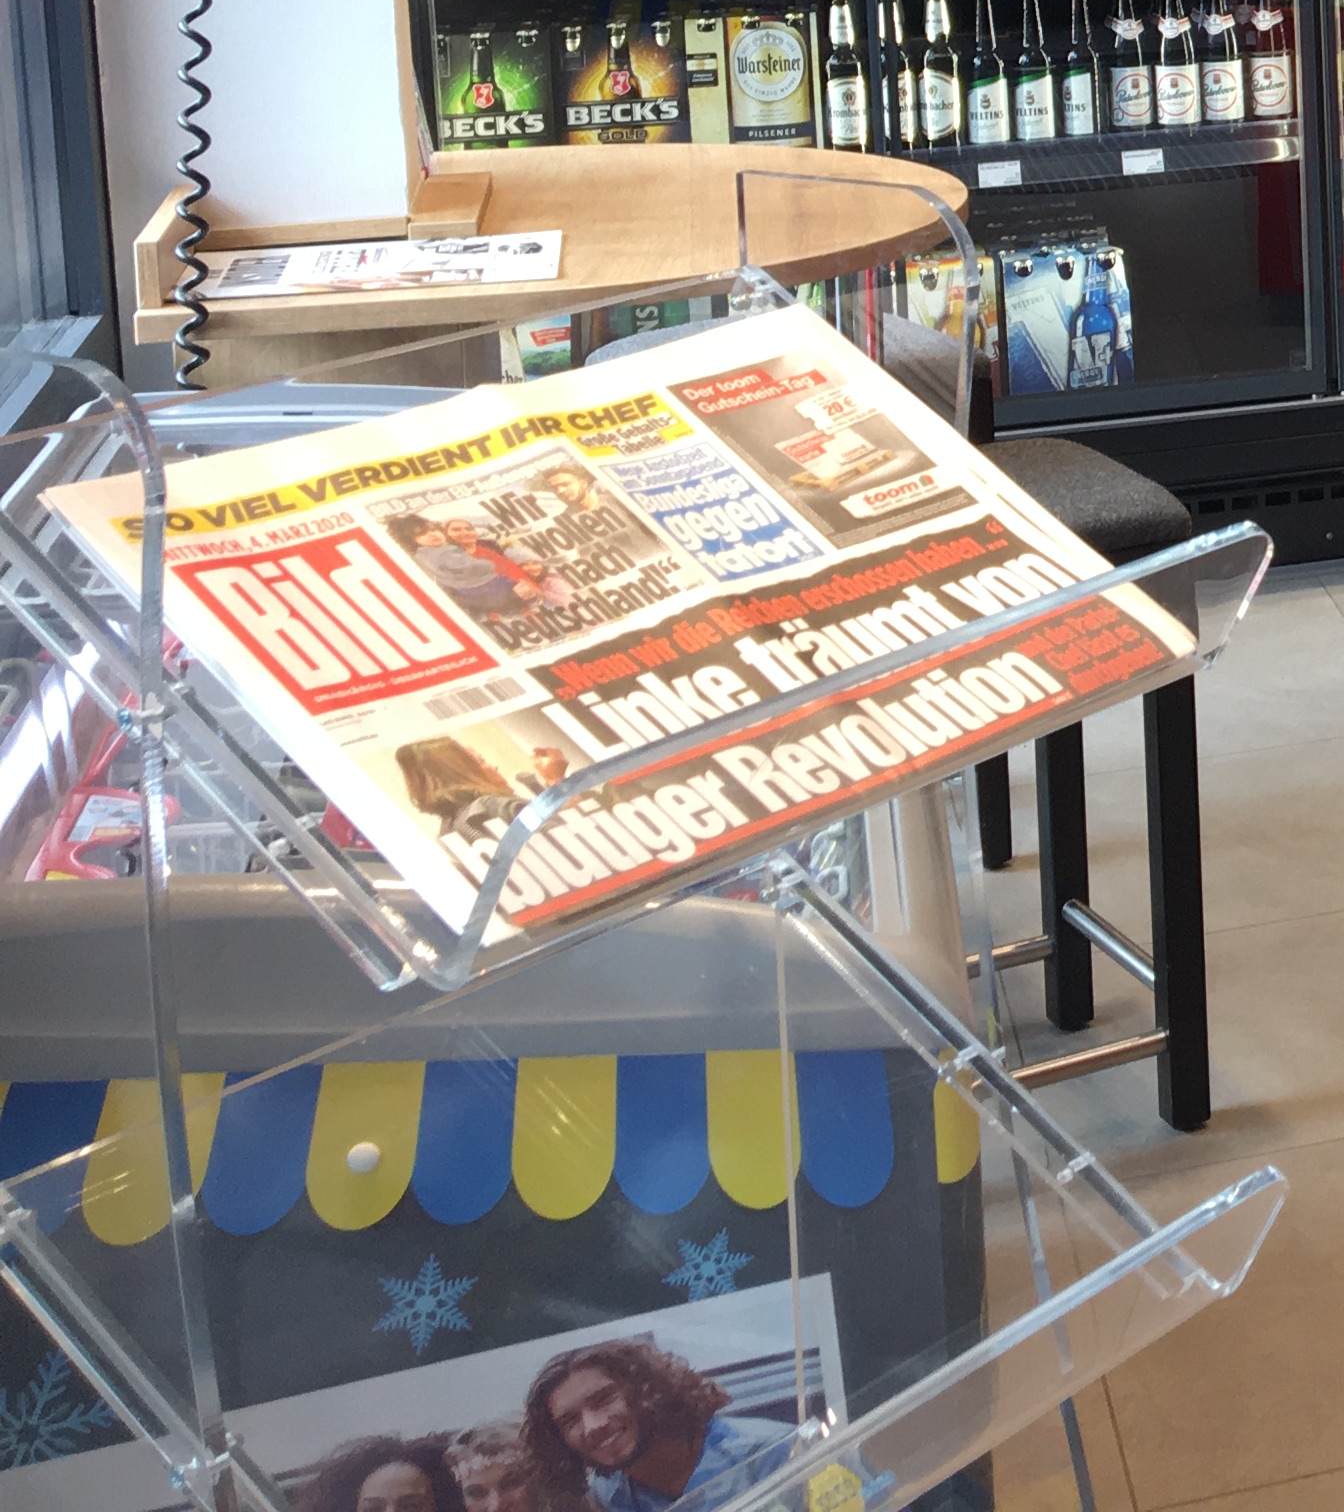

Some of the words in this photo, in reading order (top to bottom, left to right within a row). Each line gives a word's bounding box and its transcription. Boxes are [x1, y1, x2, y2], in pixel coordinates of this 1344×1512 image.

[736, 54, 802, 76] Warsteiner
[566, 99, 680, 126] BECK'S
[598, 129, 649, 143] GOLD
[748, 127, 797, 139] PILSENER
[682, 383, 716, 402] Der
[715, 372, 761, 394] toom
[698, 374, 815, 415] Gutschein-Tag
[821, 400, 843, 418] 20
[575, 426, 622, 449] Große
[618, 415, 673, 443] Gehalts-
[610, 432, 666, 456] Tabelle
[195, 491, 297, 530] VIEL
[297, 434, 506, 504] VERDIENT
[499, 413, 564, 450] IHR
[566, 394, 661, 432] CHEF
[636, 472, 750, 512] Bundesliga
[861, 481, 920, 506] toom
[311, 511, 355, 534] 2020
[520, 504, 627, 559] wollen
[662, 493, 780, 550] gegen
[557, 540, 637, 590] nach
[194, 539, 467, 691] Bild
[484, 556, 682, 651] Deutschland!“
[628, 630, 680, 666] wir
[677, 610, 723, 648] die
[706, 583, 811, 637] Reichen
[796, 555, 922, 613] erschossen
[909, 531, 989, 579] haben
[540, 661, 760, 762] Linke
[734, 583, 967, 696] träumt
[939, 552, 1082, 633] von
[440, 766, 732, 908] blutiger
[711, 650, 1064, 814] Revolution
